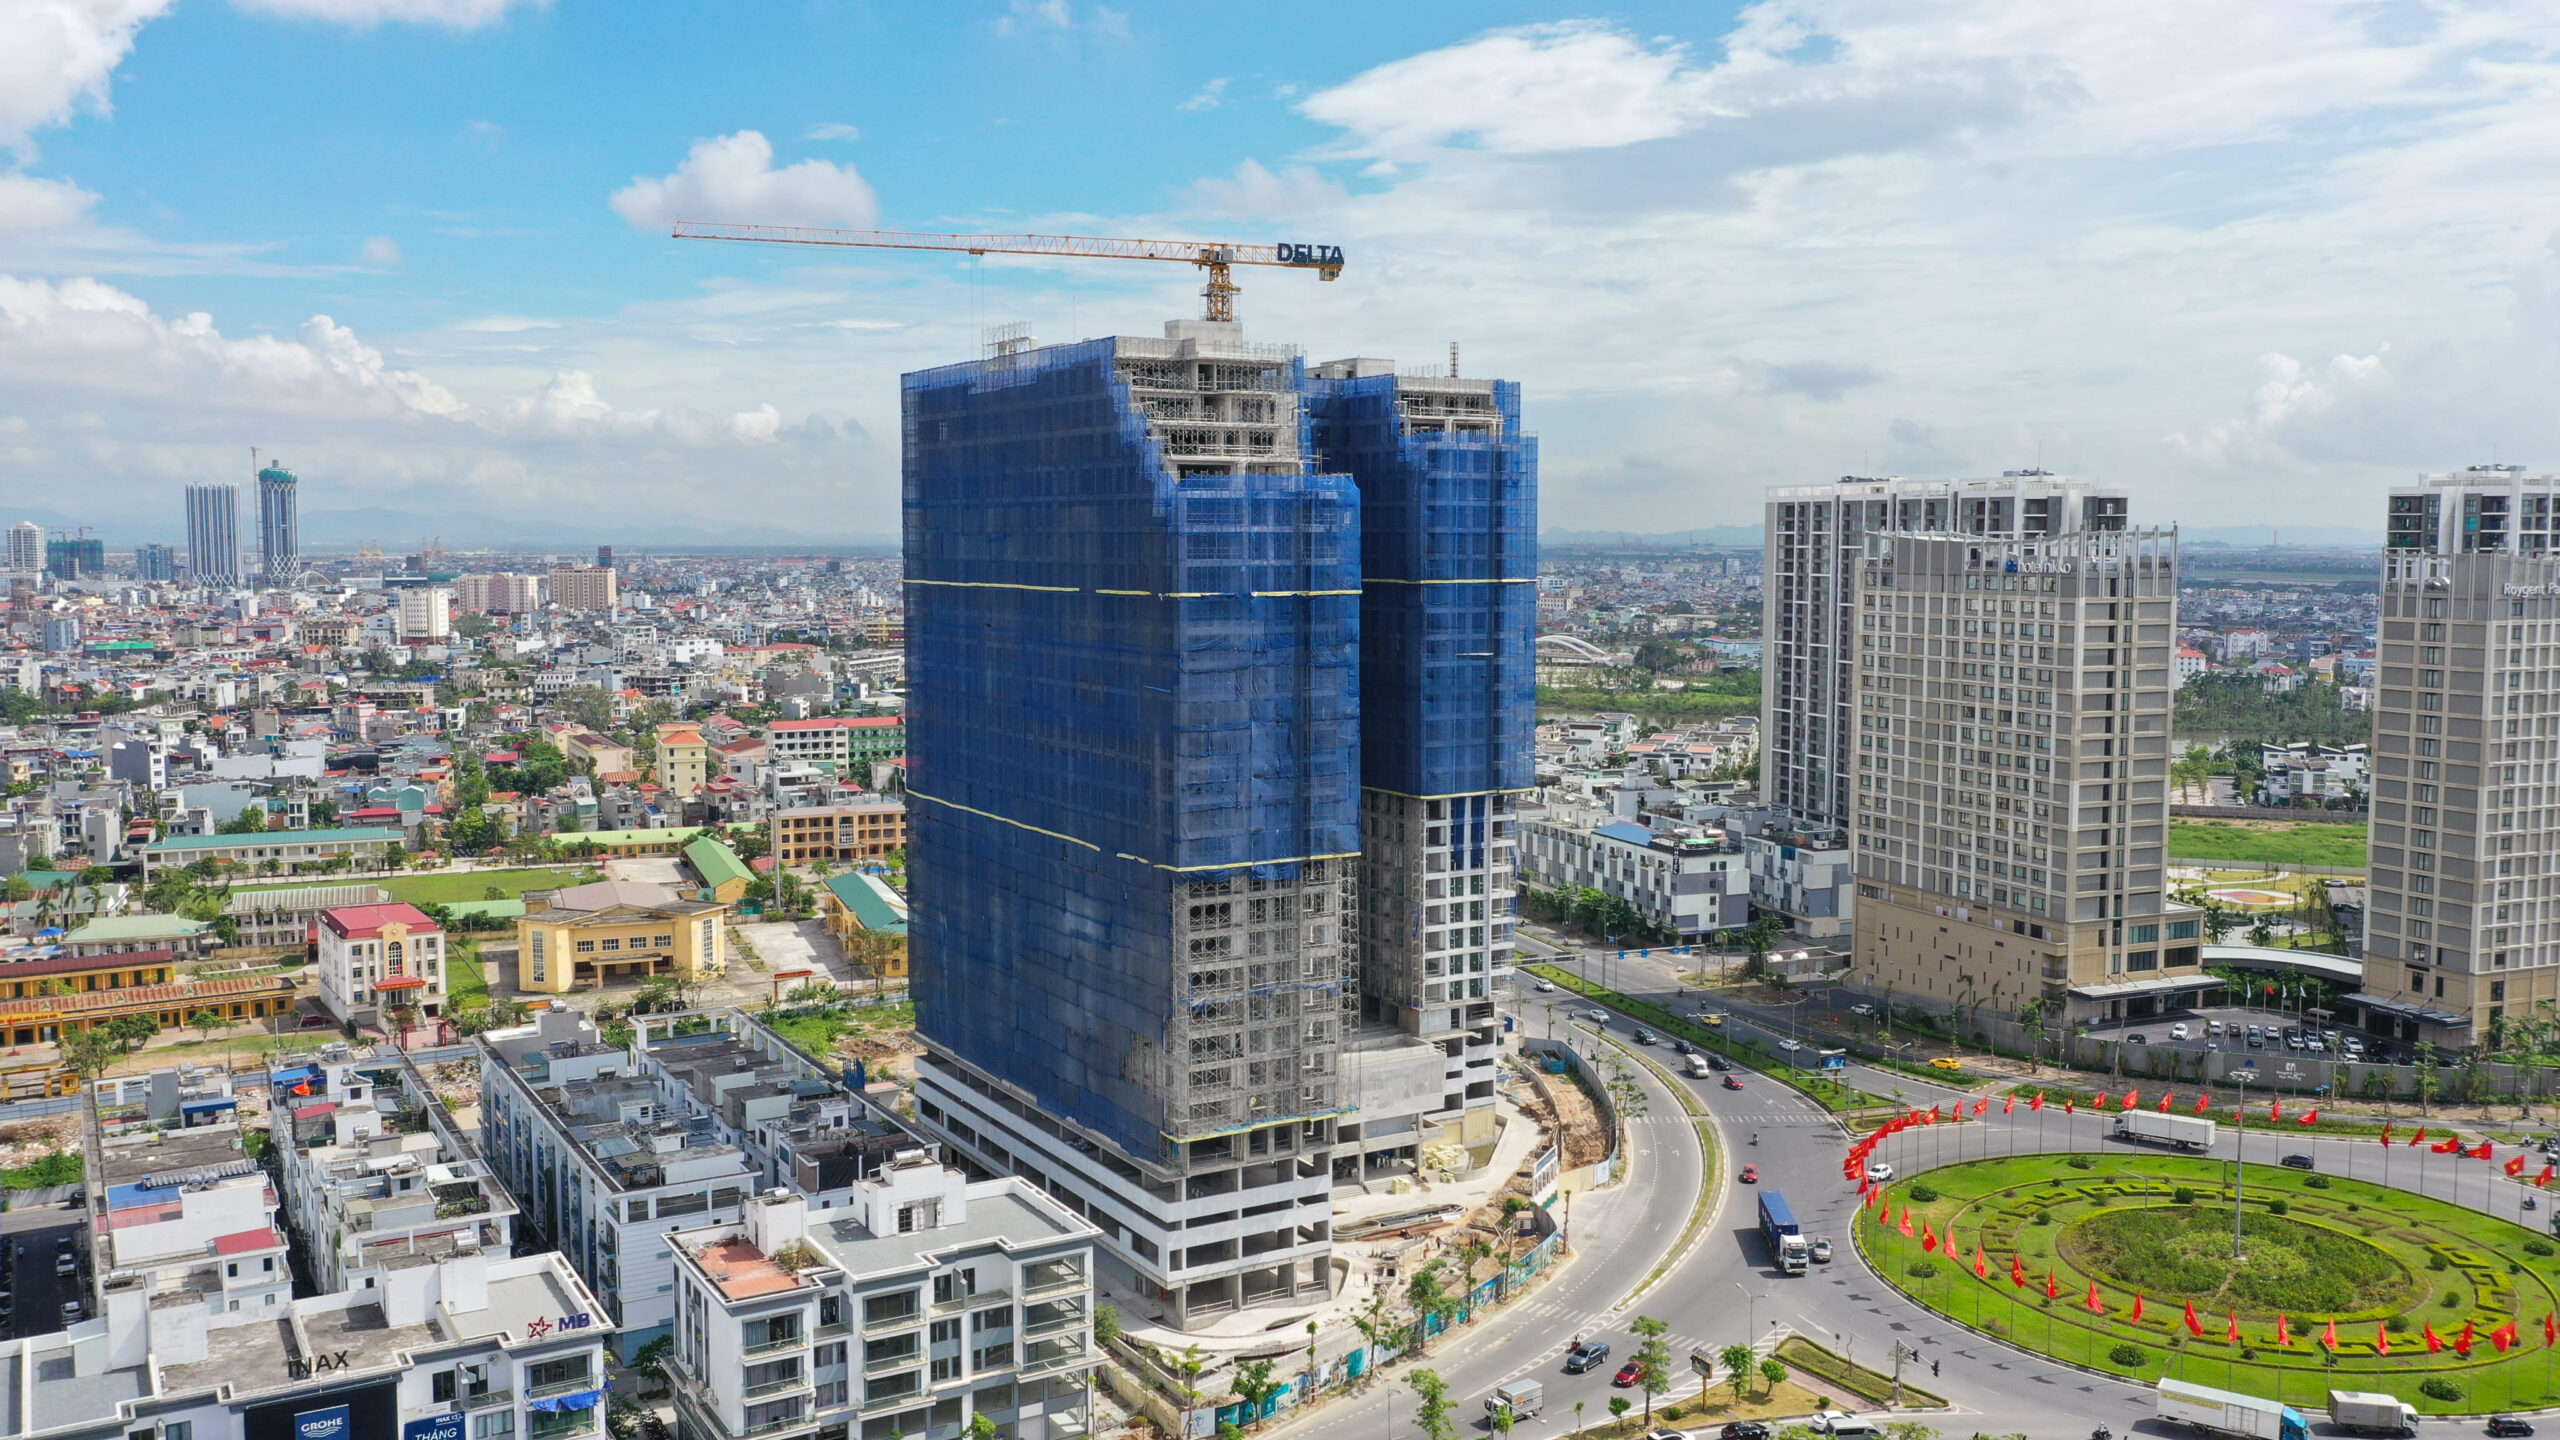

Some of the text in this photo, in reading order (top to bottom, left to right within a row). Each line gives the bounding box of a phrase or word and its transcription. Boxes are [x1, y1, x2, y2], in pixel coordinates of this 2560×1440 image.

[1277, 243, 1345, 265] DELTA
[2503, 582, 2545, 598] Roygent
[558, 1312, 591, 1332] MB
[288, 1350, 350, 1378] INAX
[301, 1417, 343, 1432] GROHE
[415, 1427, 457, 1440] THÁNG
